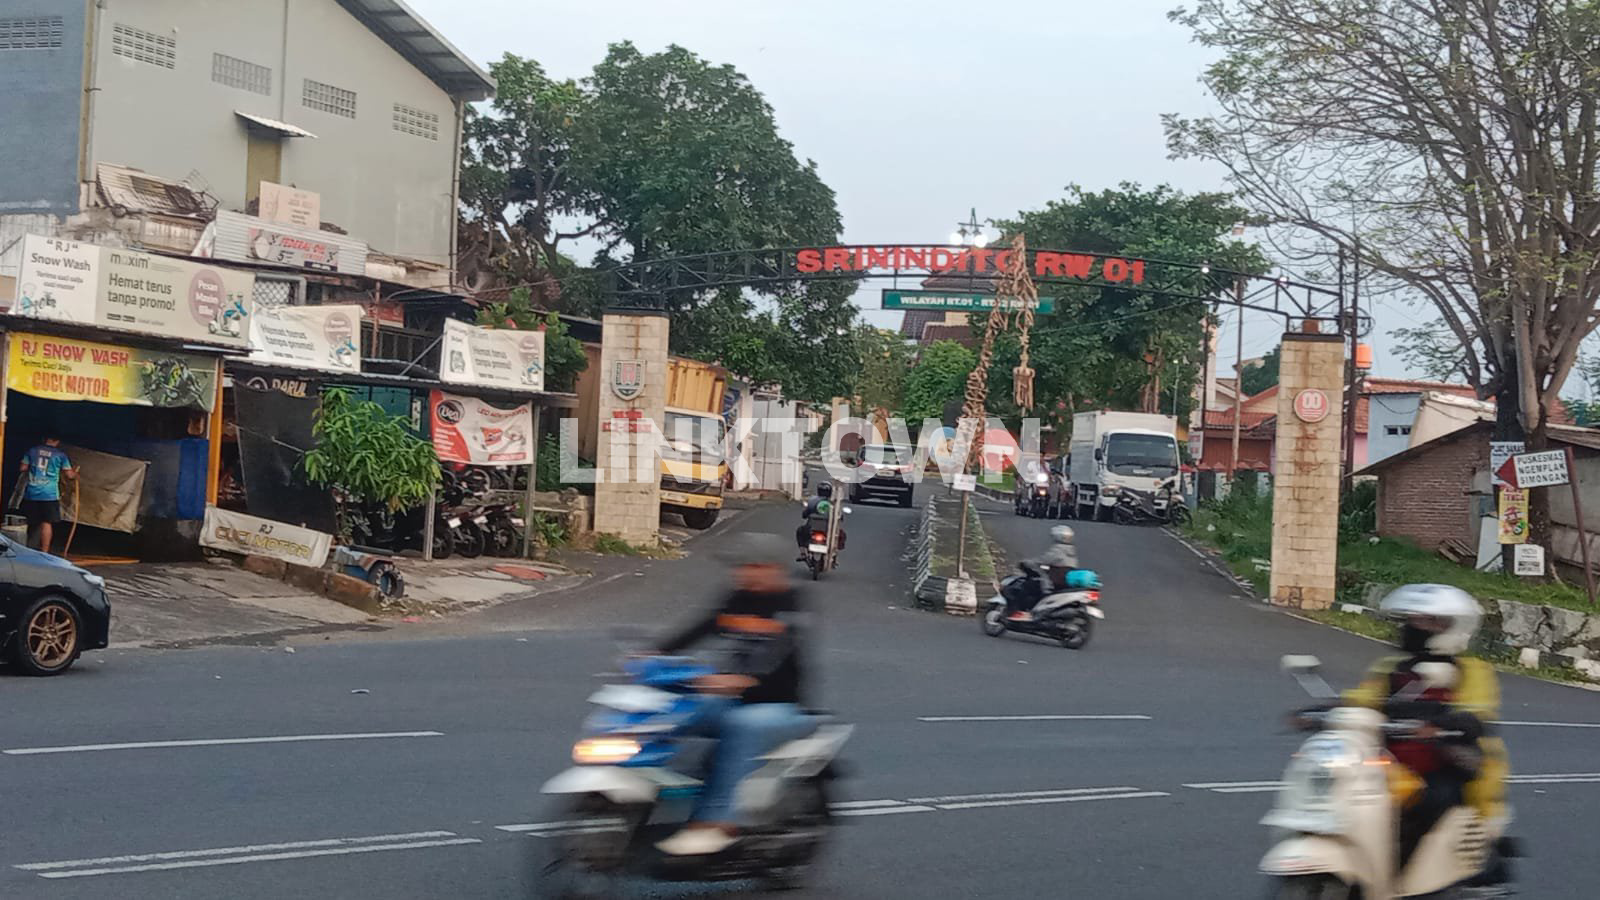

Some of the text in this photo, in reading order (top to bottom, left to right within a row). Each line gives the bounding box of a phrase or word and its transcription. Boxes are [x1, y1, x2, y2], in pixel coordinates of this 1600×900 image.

[31, 252, 91, 271] Snow Wash
[1035, 251, 1093, 279] RW
[1103, 258, 1144, 285] 01
[109, 273, 172, 295] Hemat terus
[107, 290, 176, 311] tanpa promo!
[901, 297, 945, 306] WILAYAH
[22, 340, 129, 368] RJ SNOW WASH
[32, 371, 110, 398] CUCI MOTOR
[258, 524, 274, 535] RJ
